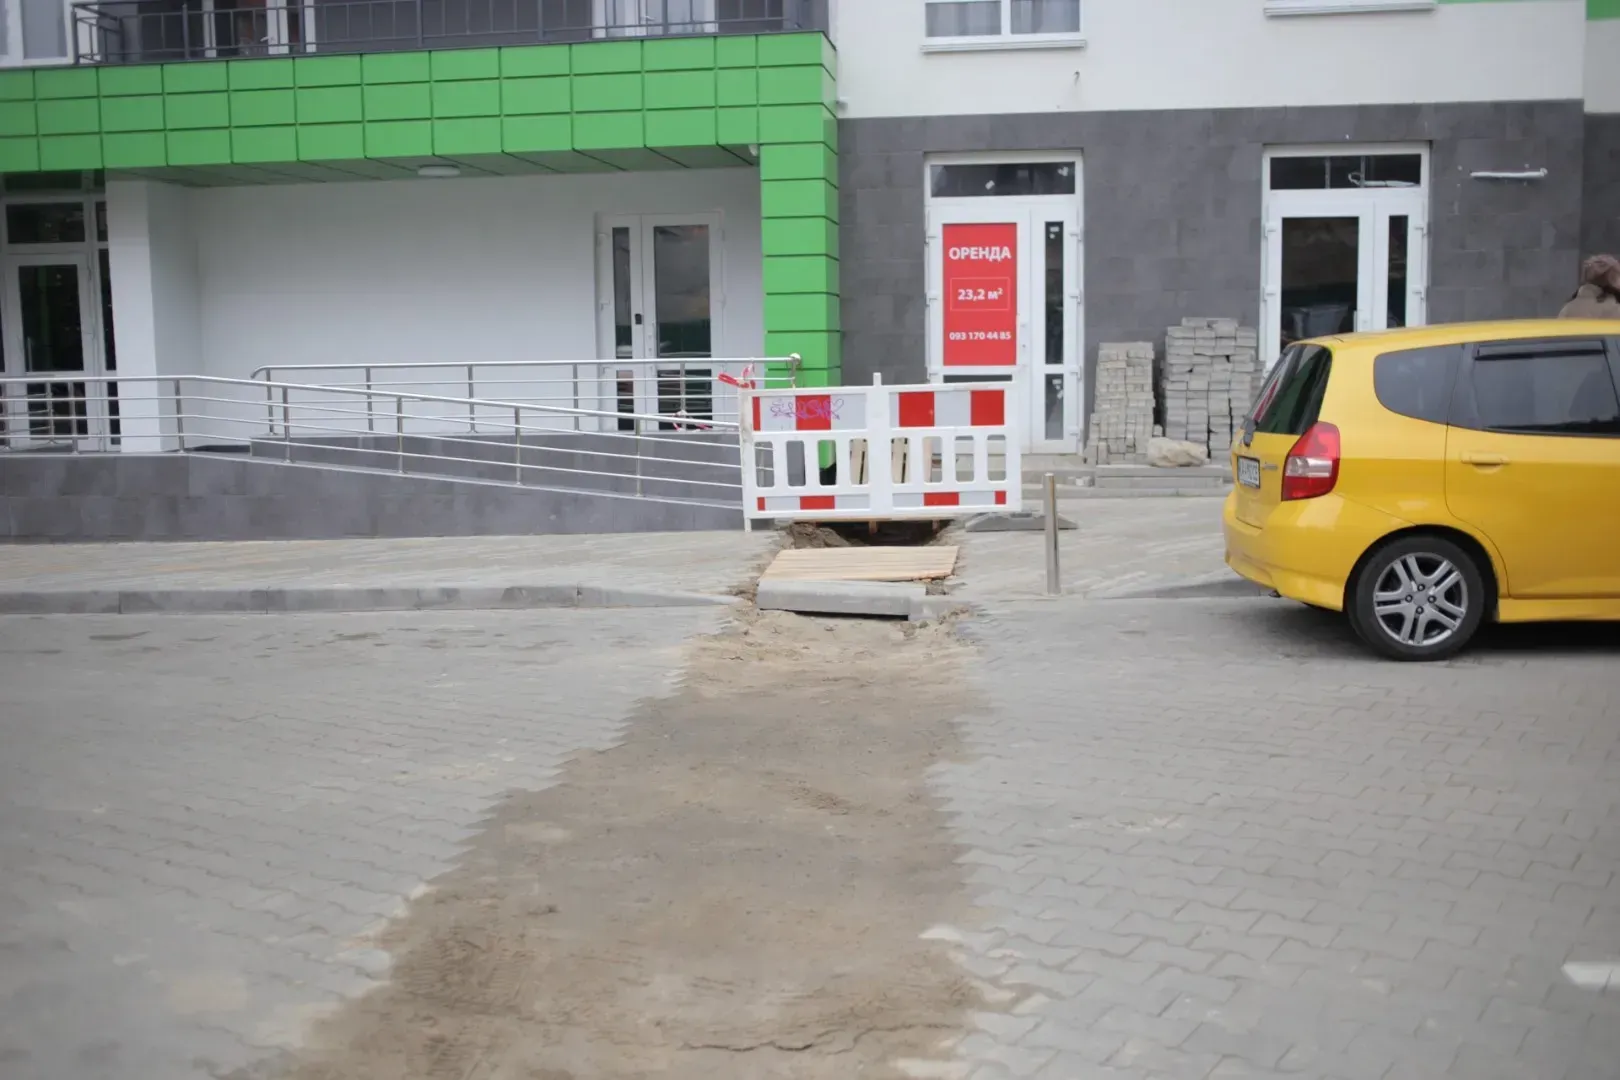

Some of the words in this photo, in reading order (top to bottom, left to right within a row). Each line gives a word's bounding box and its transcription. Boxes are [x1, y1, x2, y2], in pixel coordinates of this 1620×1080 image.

[949, 246, 1012, 262] ОРЕНДА
[958, 289, 985, 301] 23,2
[949, 331, 966, 340] 093
[968, 331, 985, 340] 170
[987, 331, 998, 340] 44
[1000, 331, 1012, 340] 85
